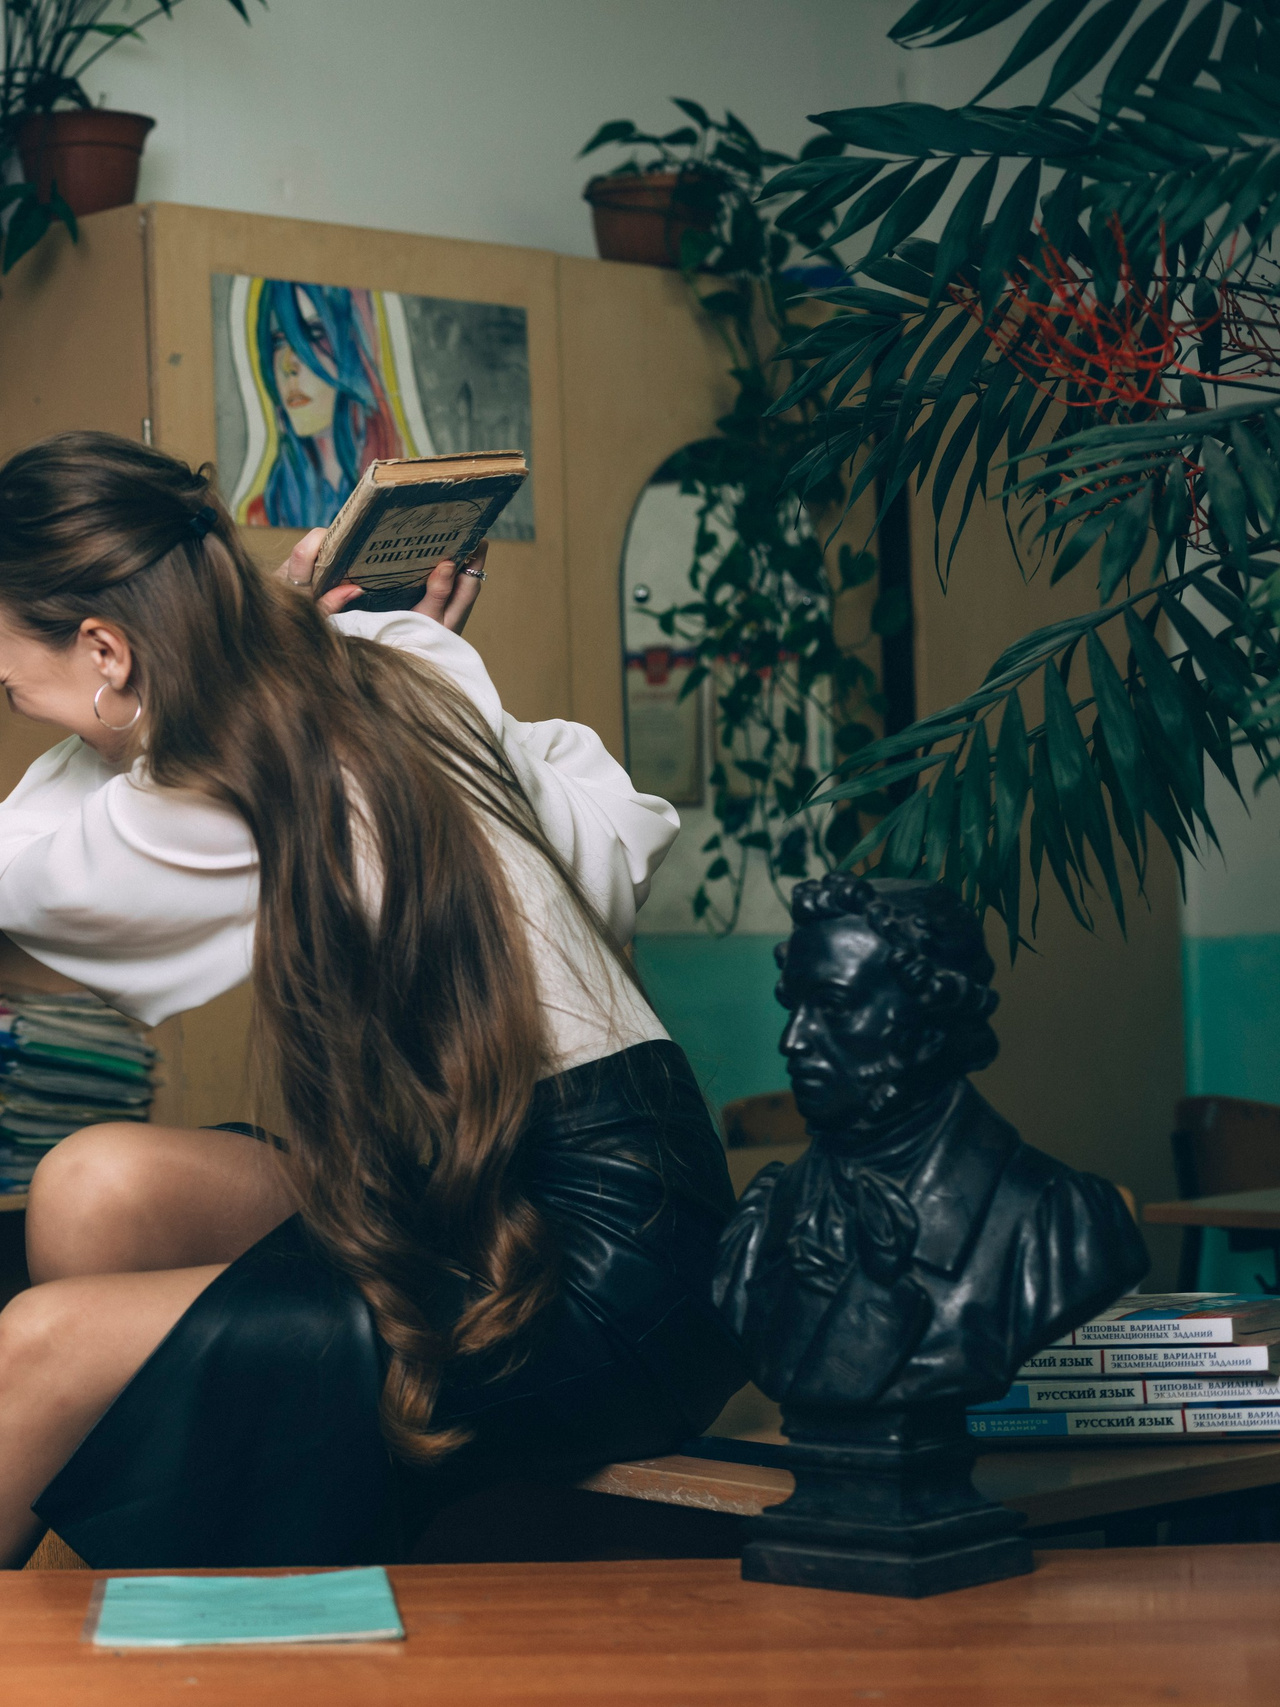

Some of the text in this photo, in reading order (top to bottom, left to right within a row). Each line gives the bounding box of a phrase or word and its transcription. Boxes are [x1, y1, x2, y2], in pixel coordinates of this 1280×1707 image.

[368, 529, 461, 551] ЕВГЕНИЙ
[365, 545, 447, 564] ОНЕГИН
[1082, 1324, 1180, 1333] ТИПОВЫЕ ВАРИАНТЫ
[1082, 1330, 1214, 1341] ЭКЗАМЕНАЦИОННЫХ ЗАДАНИЙ
[1022, 1356, 1093, 1368] СКИЙ ЯЗЫК
[1110, 1352, 1217, 1361] ТИПОВЫЕ ВАРИАНТЫ
[1111, 1358, 1252, 1369] ЭКЗАМЕНАЦИОННЫХ ЗАДАНИЙ
[1153, 1380, 1264, 1392] ТИПОВЫЕ ВАРИАНТЫ
[1037, 1388, 1135, 1401] РУССКИЙ ЯЗЫК
[1154, 1389, 1252, 1399] ЭКЗАМЕНАЦИОННЫХ
[1192, 1412, 1242, 1421] ТИПОВЫЕ
[971, 1421, 987, 1432] 38
[1075, 1416, 1174, 1429] РУССКИЙ ЯЗЫК
